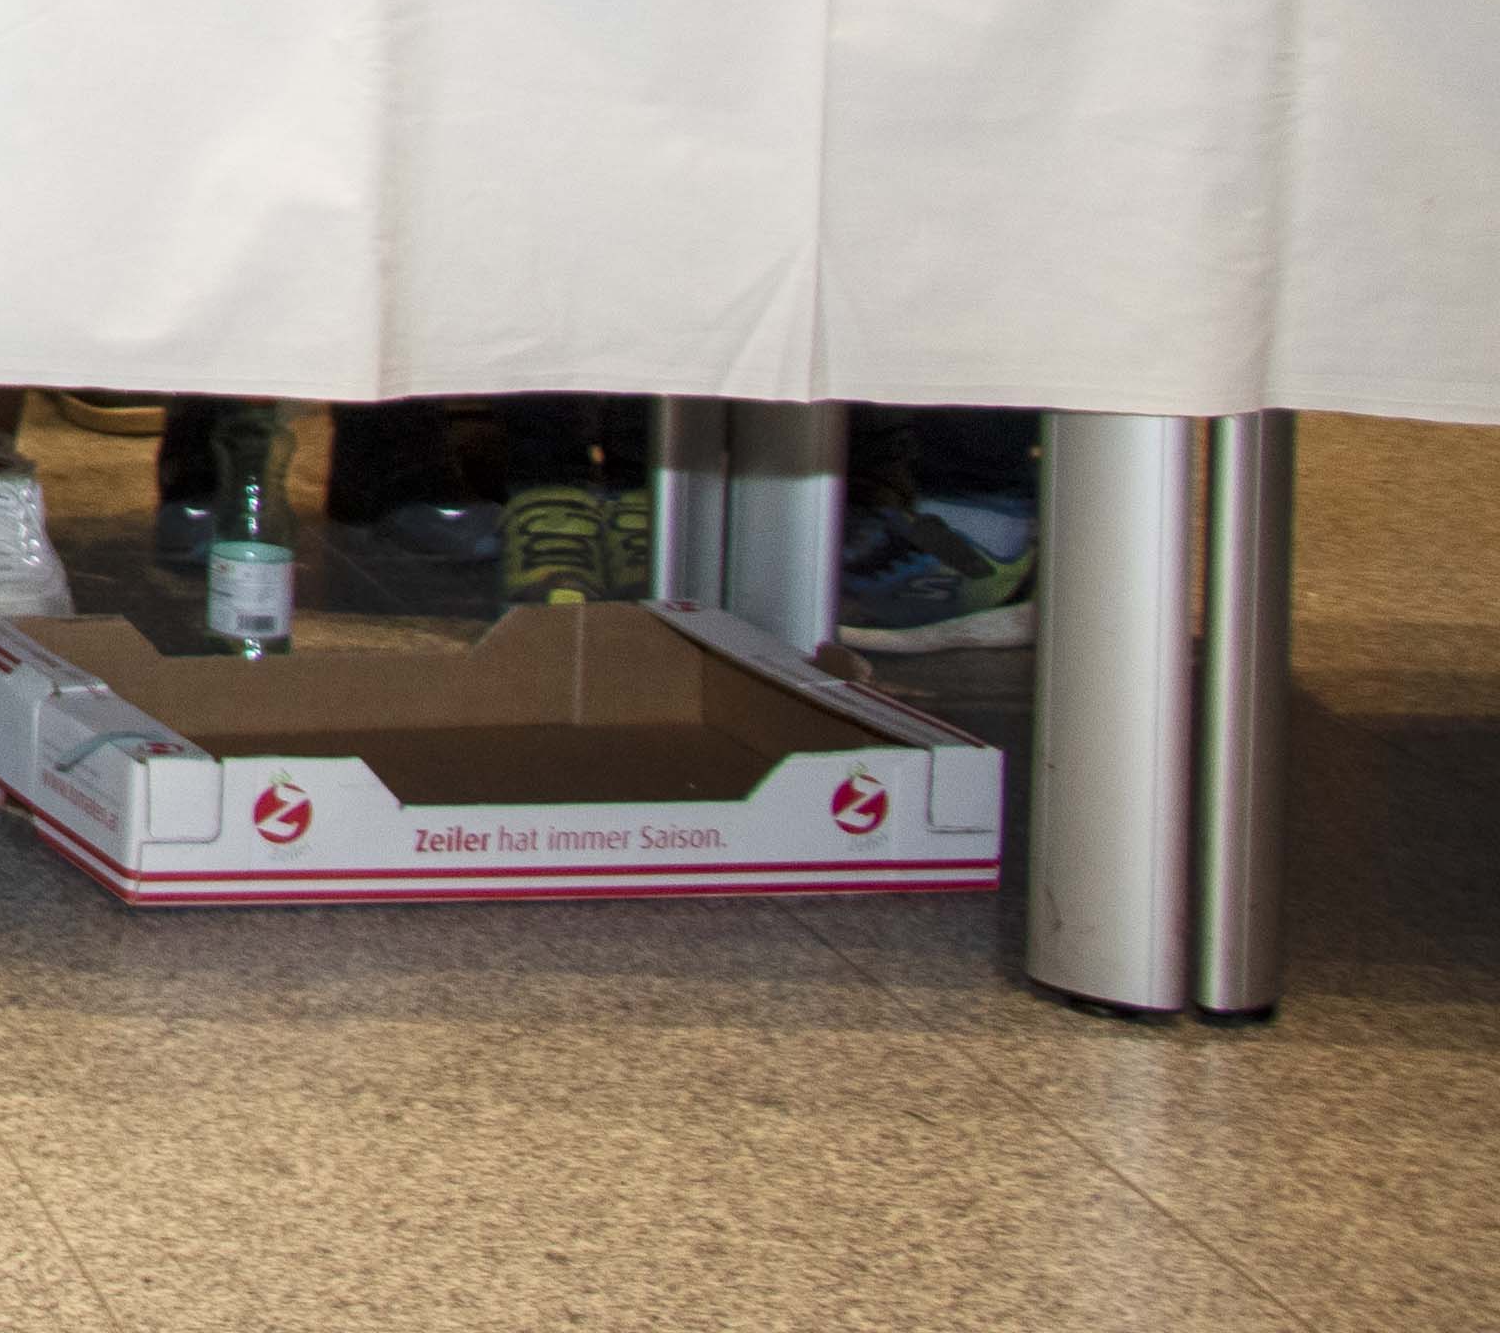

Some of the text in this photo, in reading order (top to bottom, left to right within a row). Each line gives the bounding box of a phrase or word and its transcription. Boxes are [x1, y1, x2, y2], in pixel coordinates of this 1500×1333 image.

[415, 824, 728, 852] Zeiler hat immer Saison.
